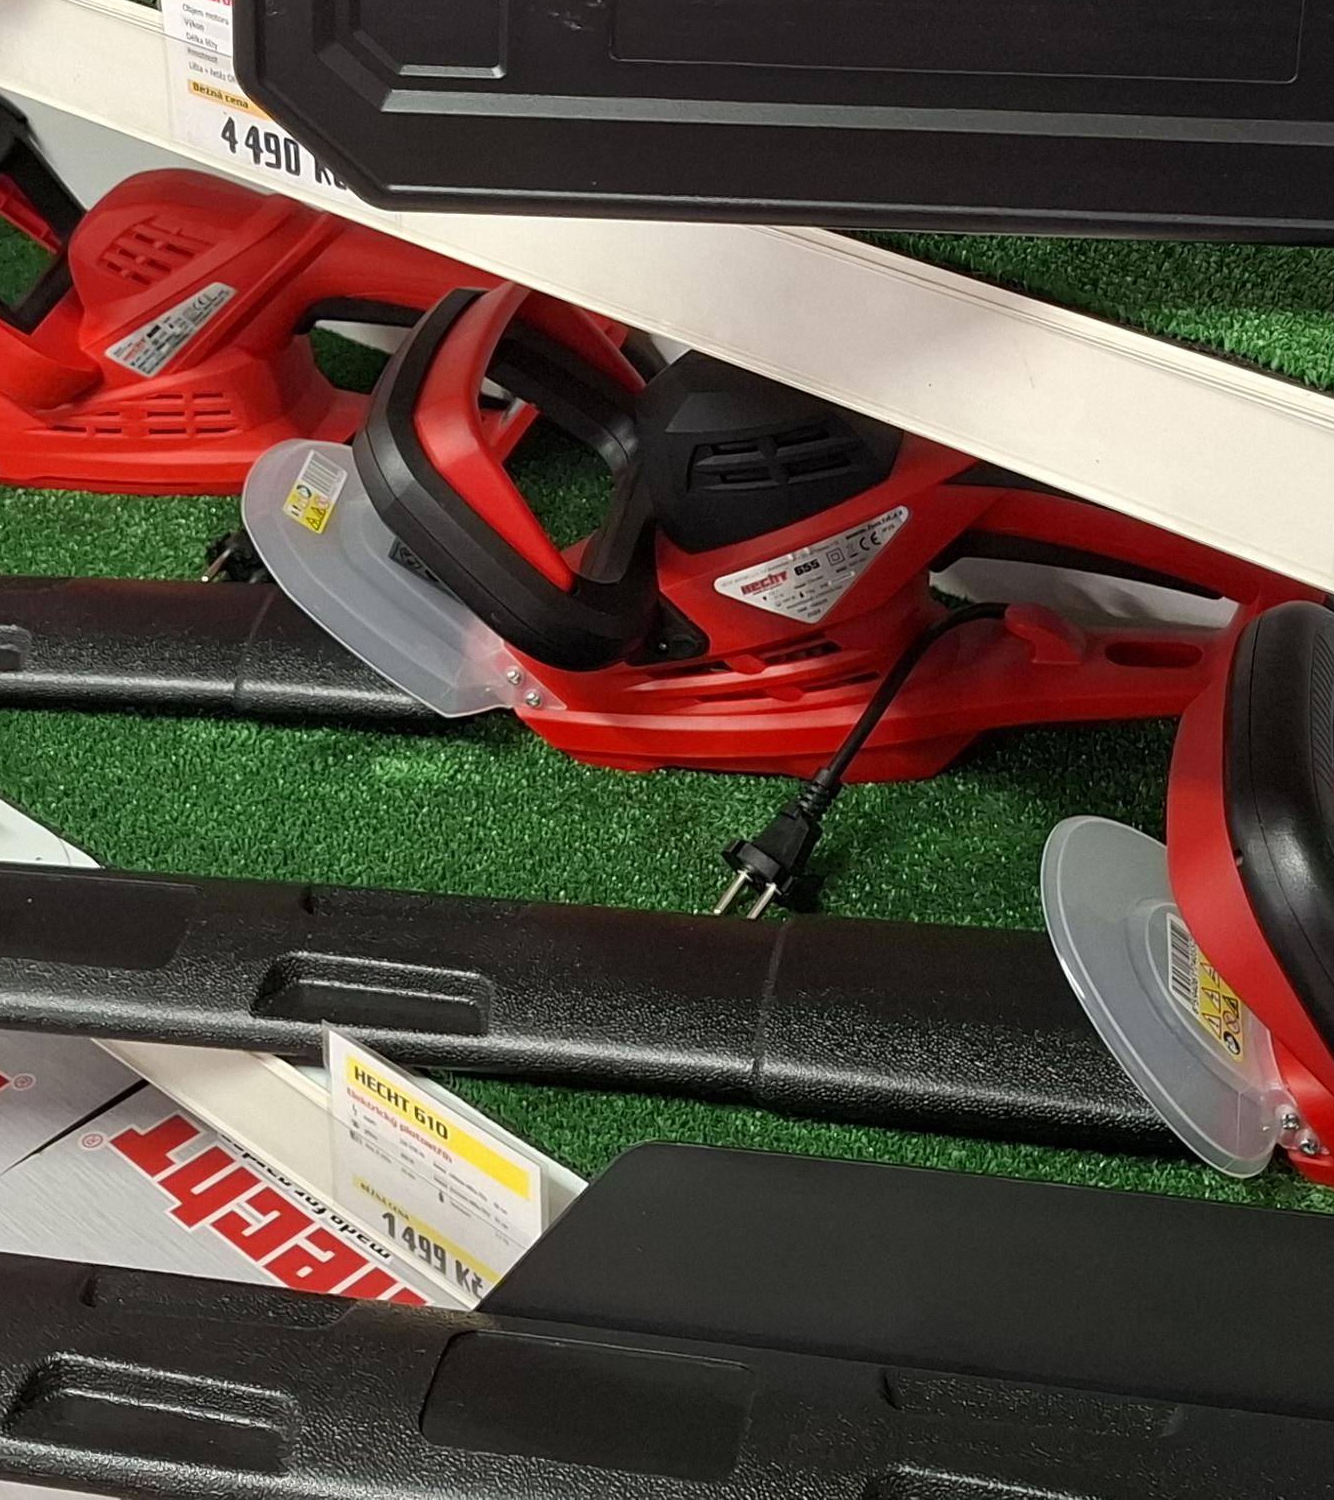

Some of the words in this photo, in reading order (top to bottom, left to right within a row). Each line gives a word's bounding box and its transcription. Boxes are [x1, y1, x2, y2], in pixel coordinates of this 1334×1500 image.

[225, 93, 249, 109] cena
[221, 116, 238, 154] 4
[244, 125, 301, 178] 490
[794, 558, 821, 576] 655
[354, 1064, 411, 1114] HECHT
[414, 1105, 449, 1142] 610
[455, 1258, 484, 1300] Kč
